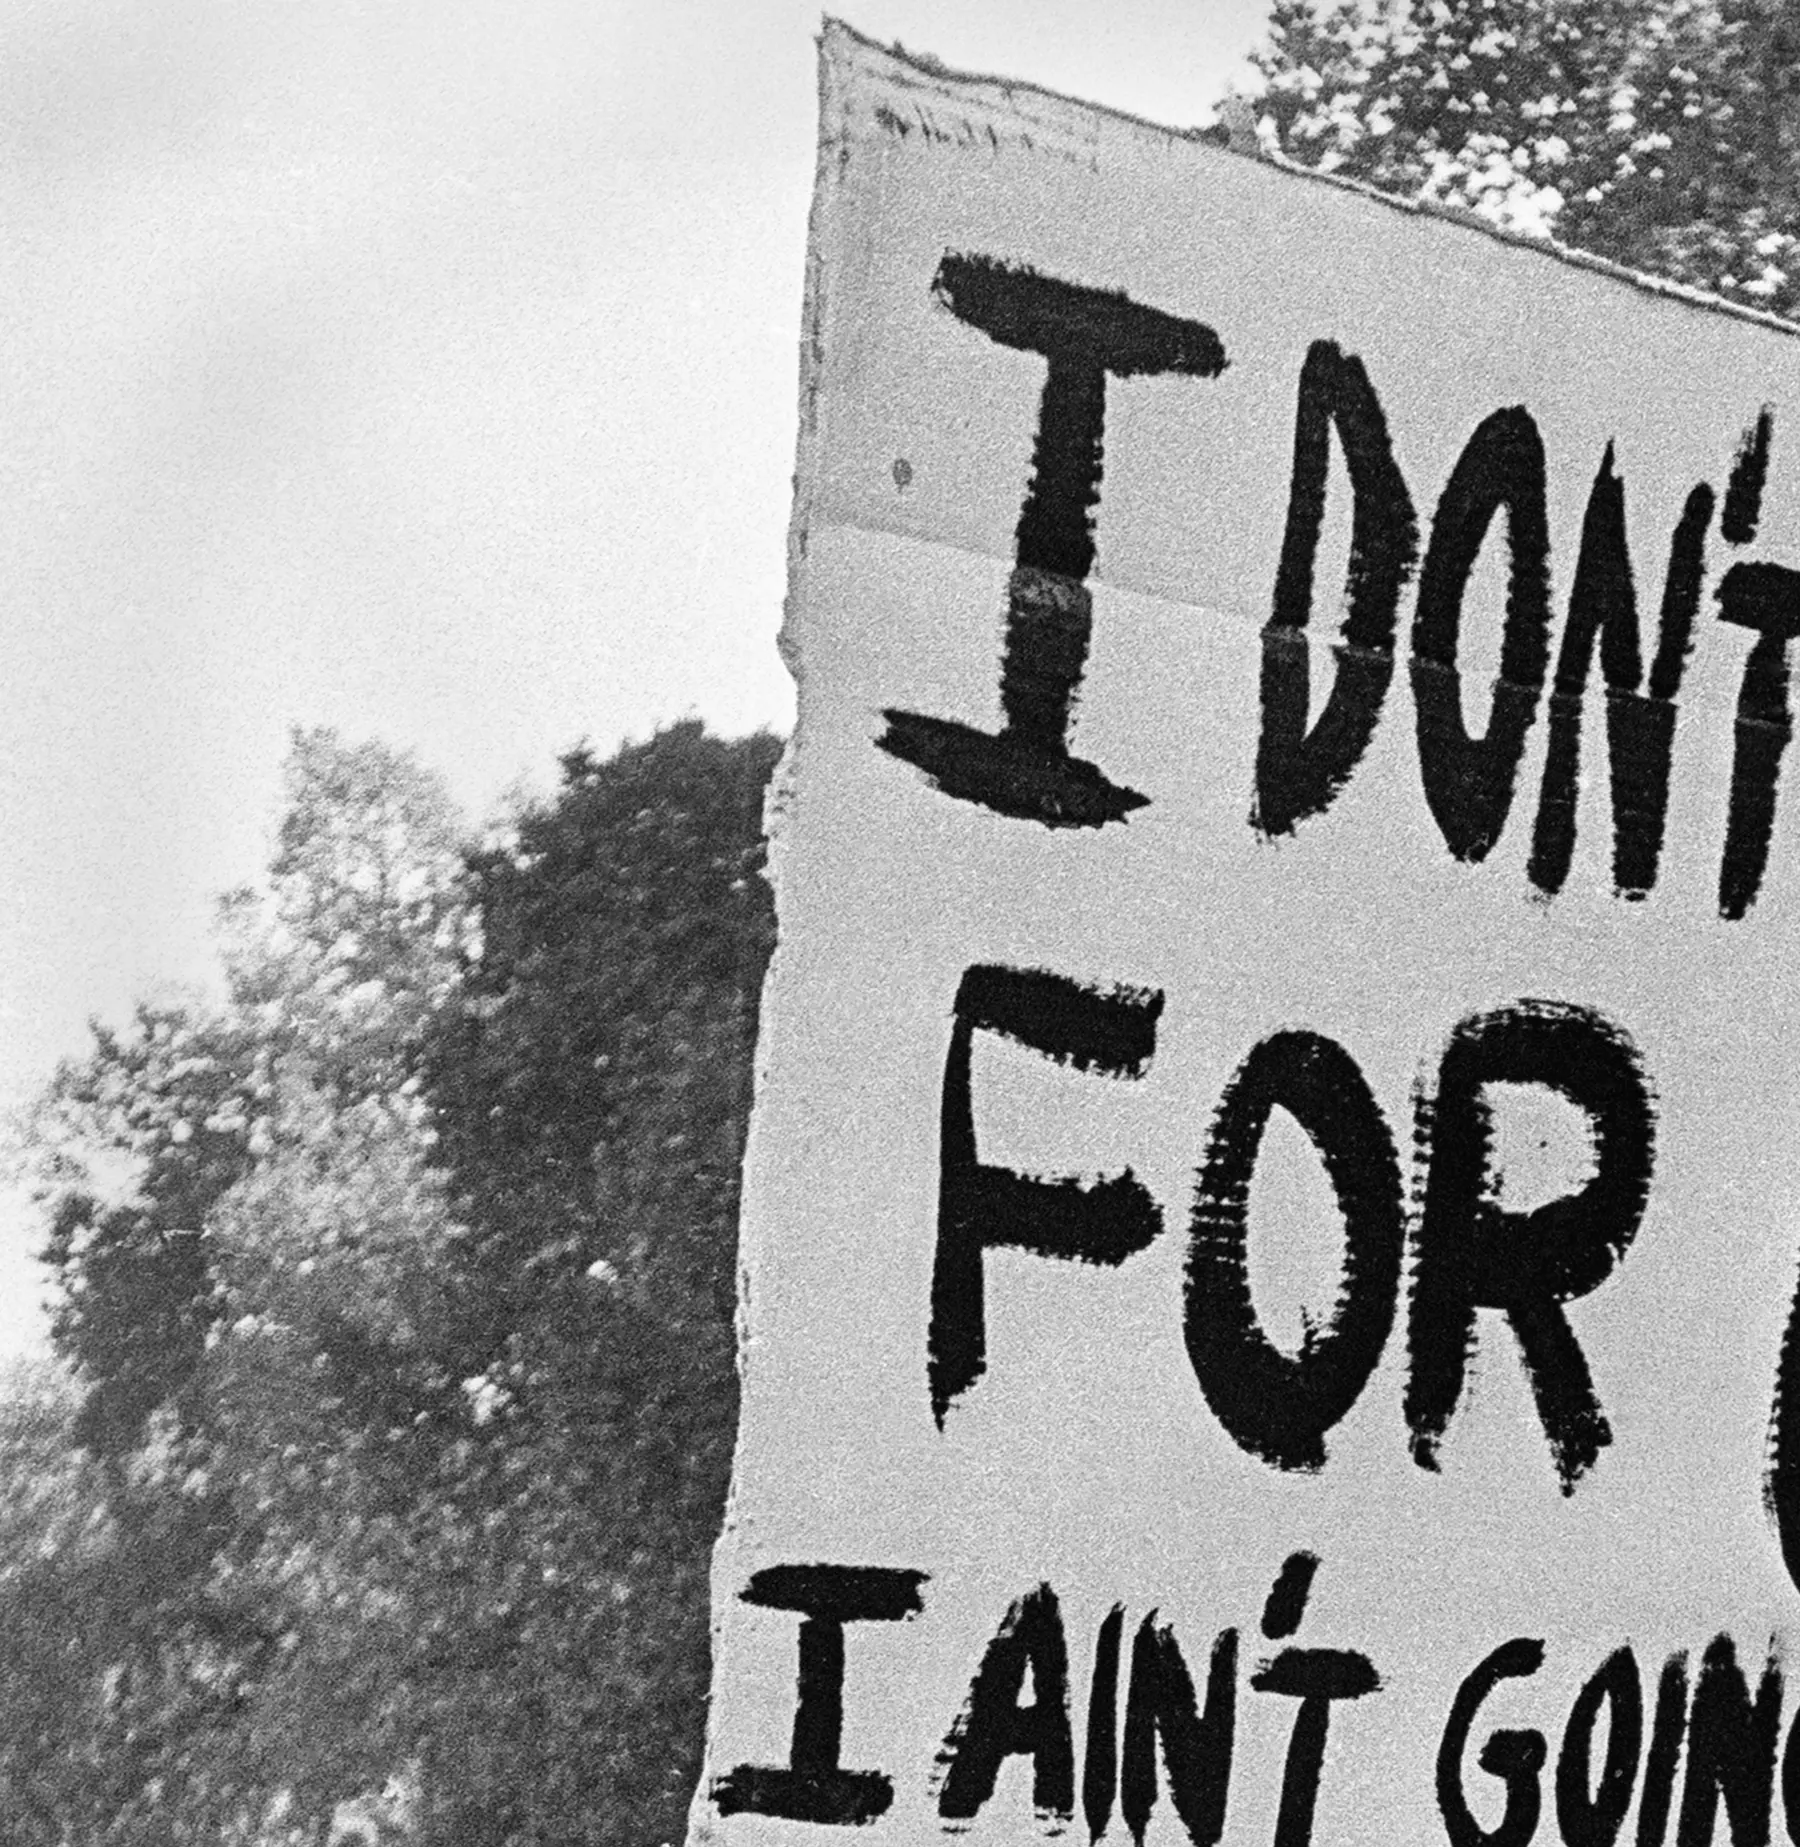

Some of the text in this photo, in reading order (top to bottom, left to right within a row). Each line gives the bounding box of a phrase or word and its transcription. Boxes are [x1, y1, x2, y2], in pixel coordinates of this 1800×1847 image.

[873, 252, 1228, 830] I
[926, 963, 1656, 1498] FOR
[709, 1562, 930, 1826] I
